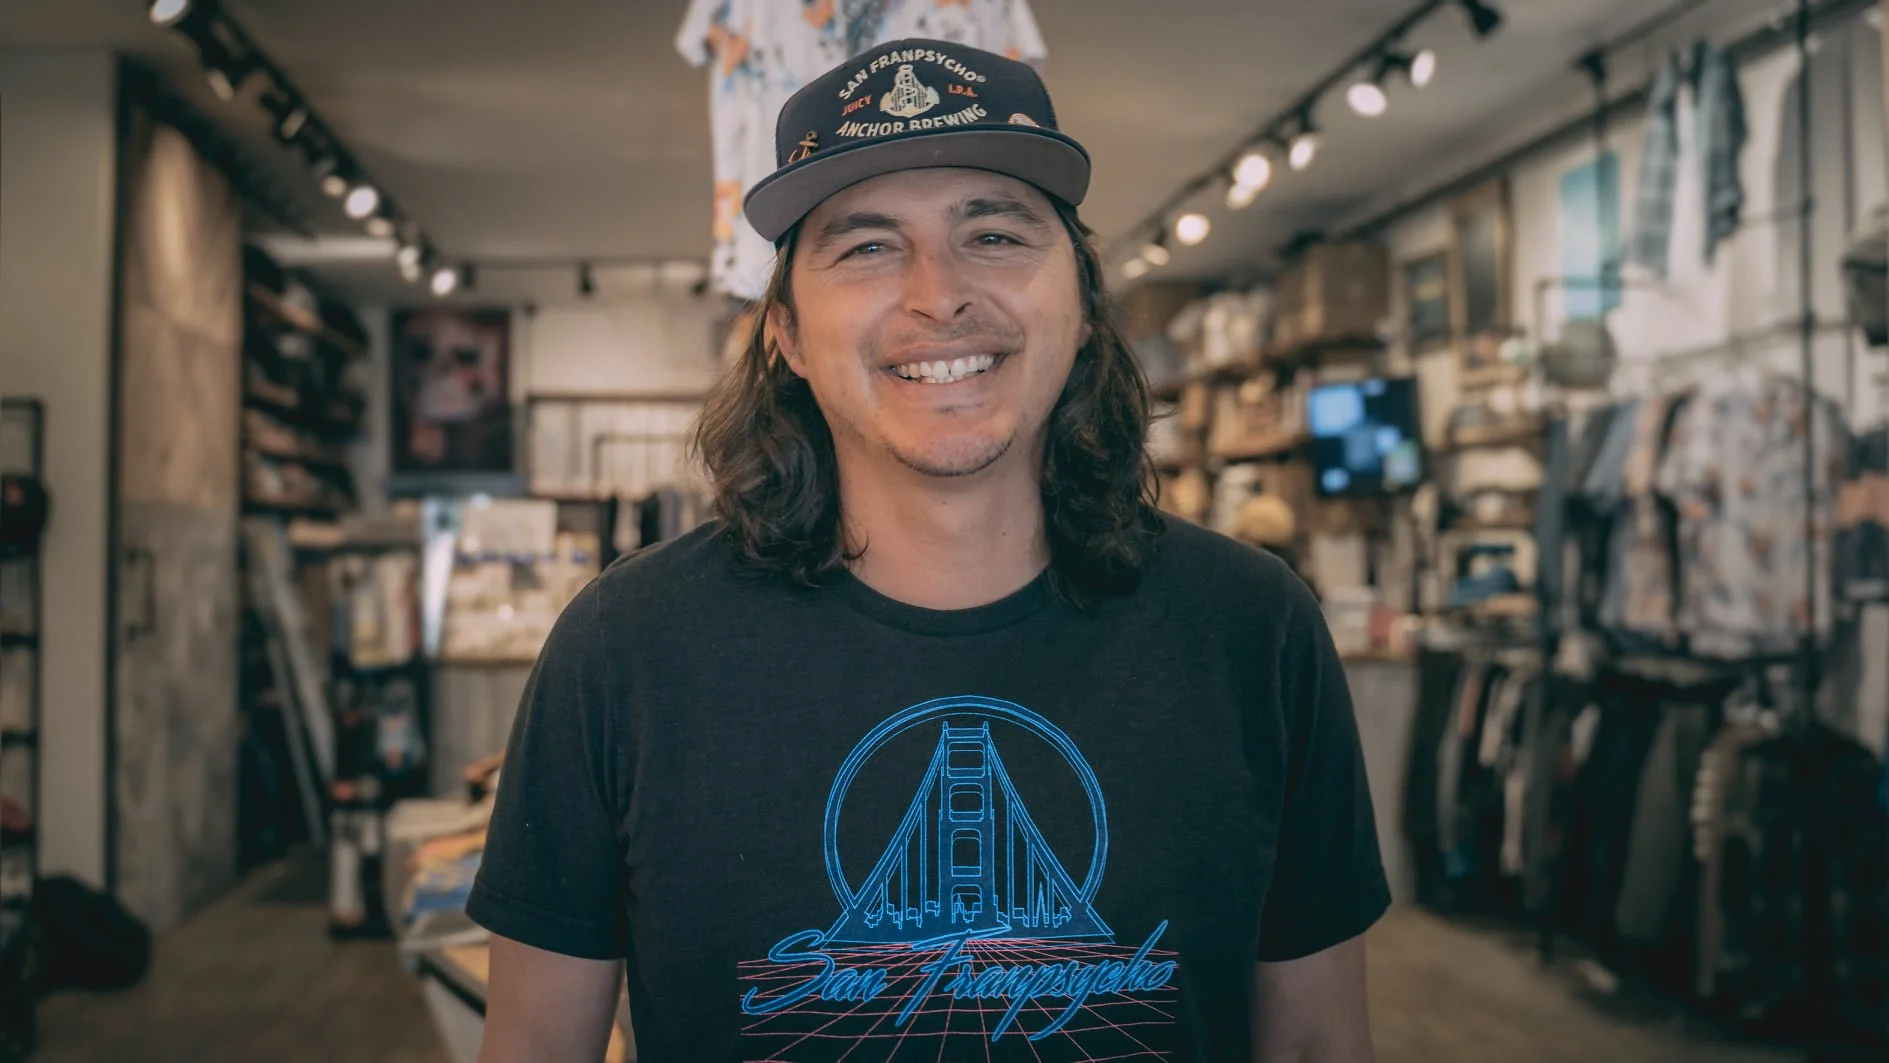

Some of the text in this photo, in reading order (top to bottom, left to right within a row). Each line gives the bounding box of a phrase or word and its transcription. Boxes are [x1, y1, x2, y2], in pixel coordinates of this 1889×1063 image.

[839, 69, 869, 100] SAN
[836, 103, 987, 137] ANCHOR BREWING
[841, 95, 872, 117] JUICY
[742, 919, 1177, 1042] San Franpsycho
